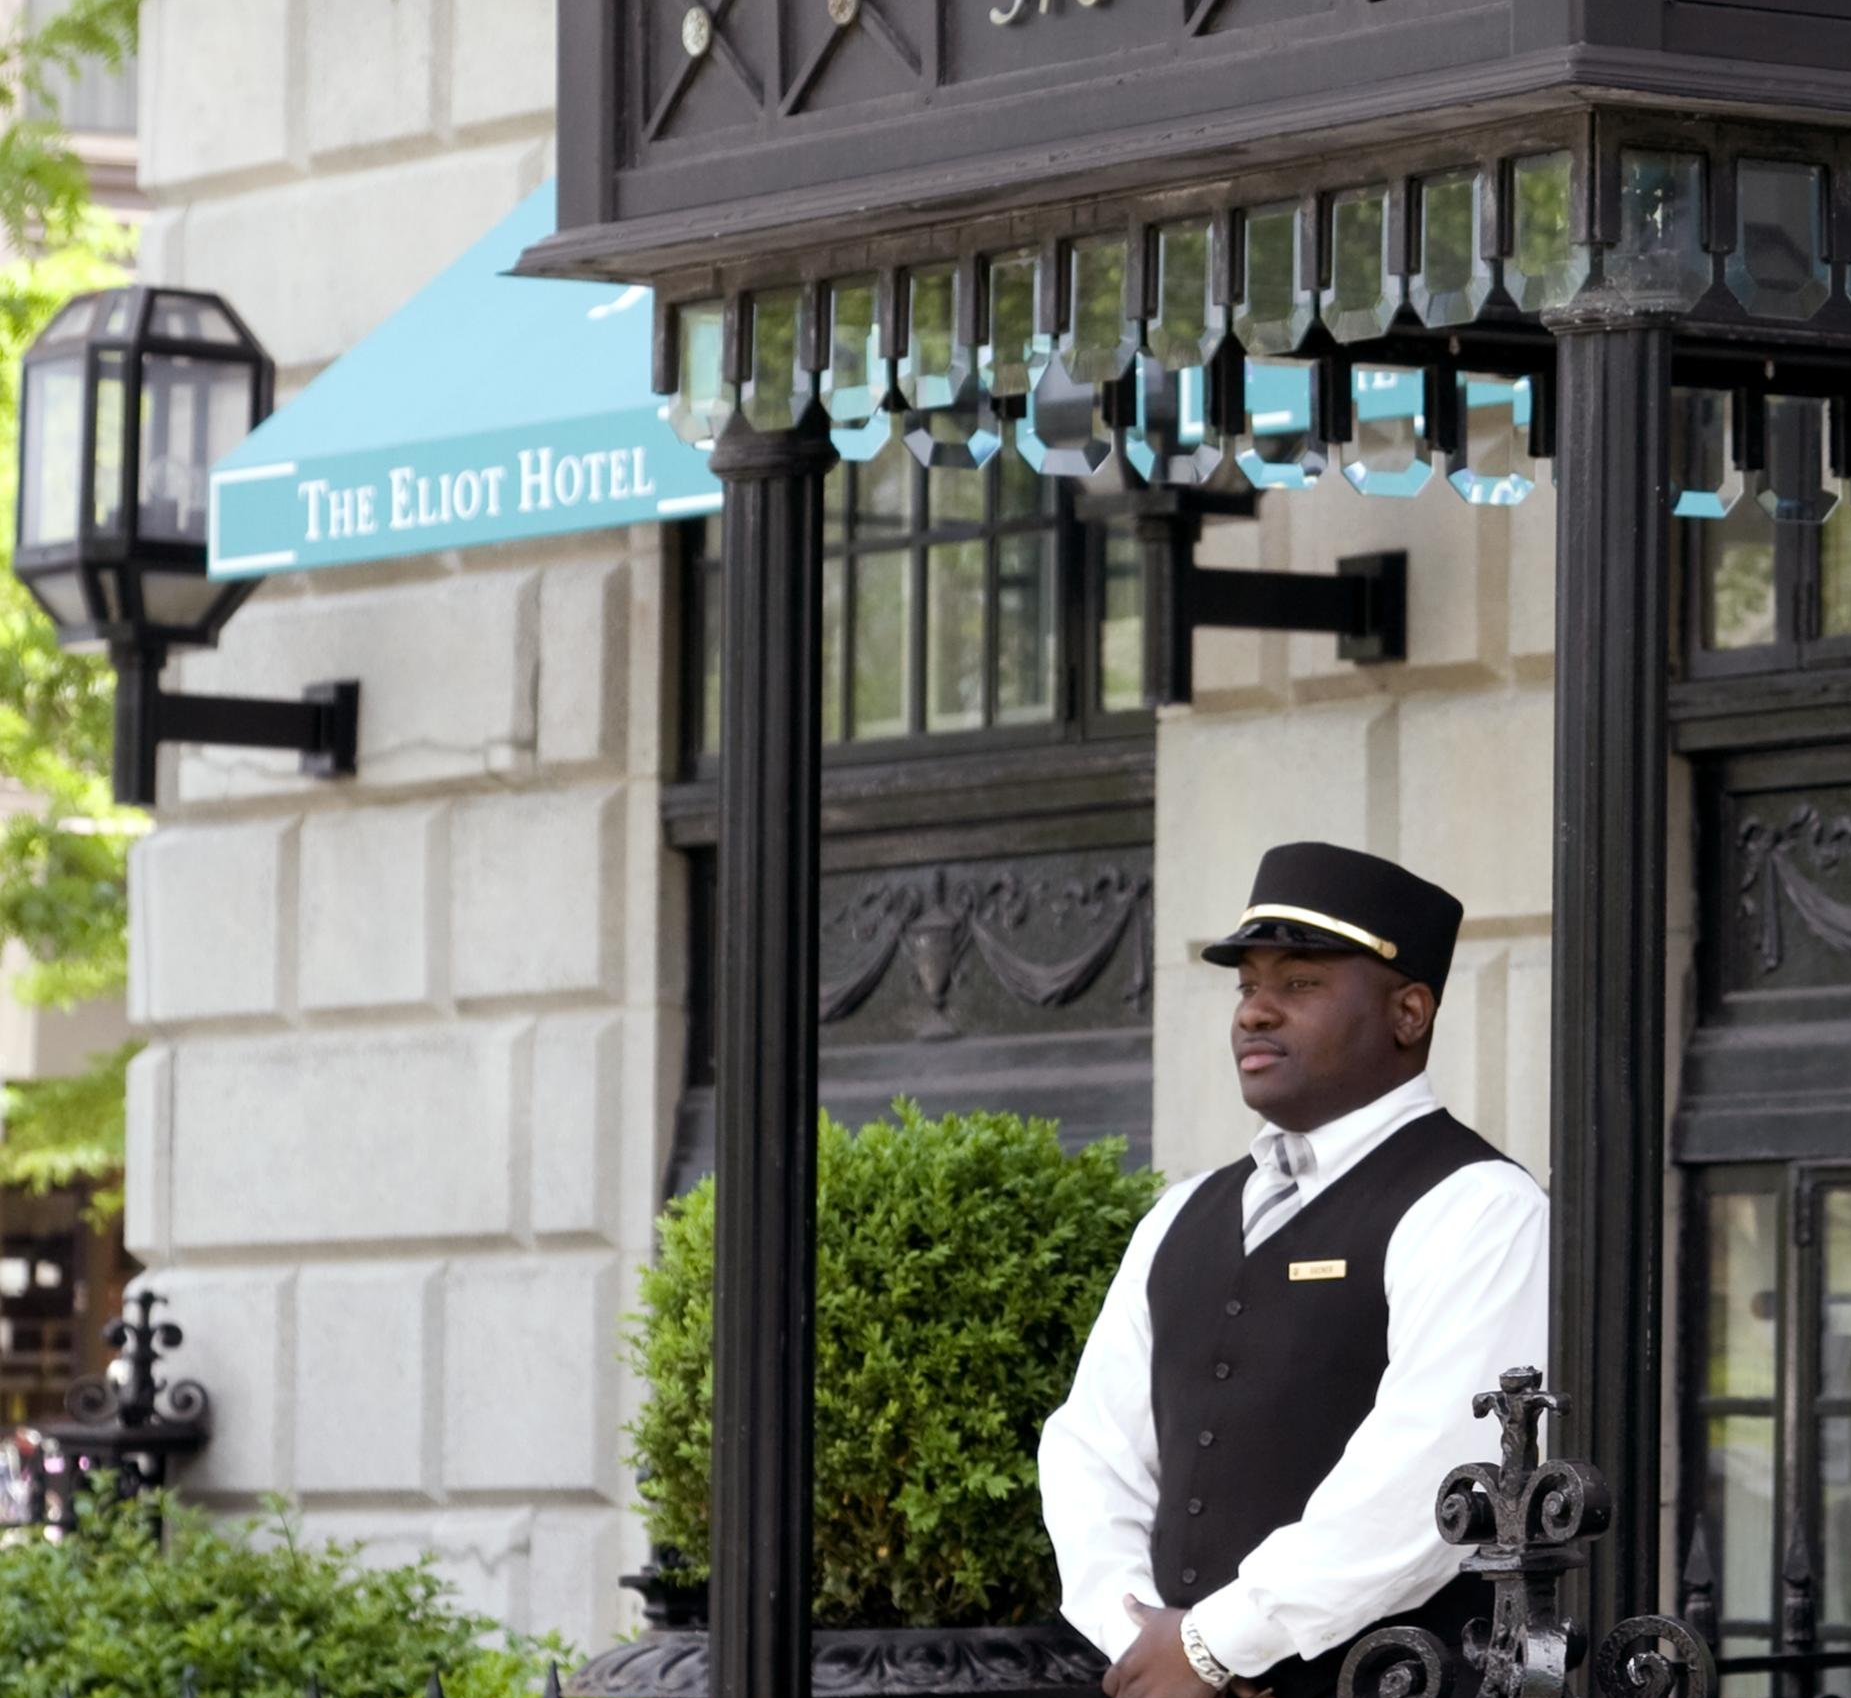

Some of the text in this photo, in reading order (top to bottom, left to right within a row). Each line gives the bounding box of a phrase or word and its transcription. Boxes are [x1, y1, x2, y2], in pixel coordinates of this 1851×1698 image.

[297, 445, 655, 542] THE ELIOT HOTEL
